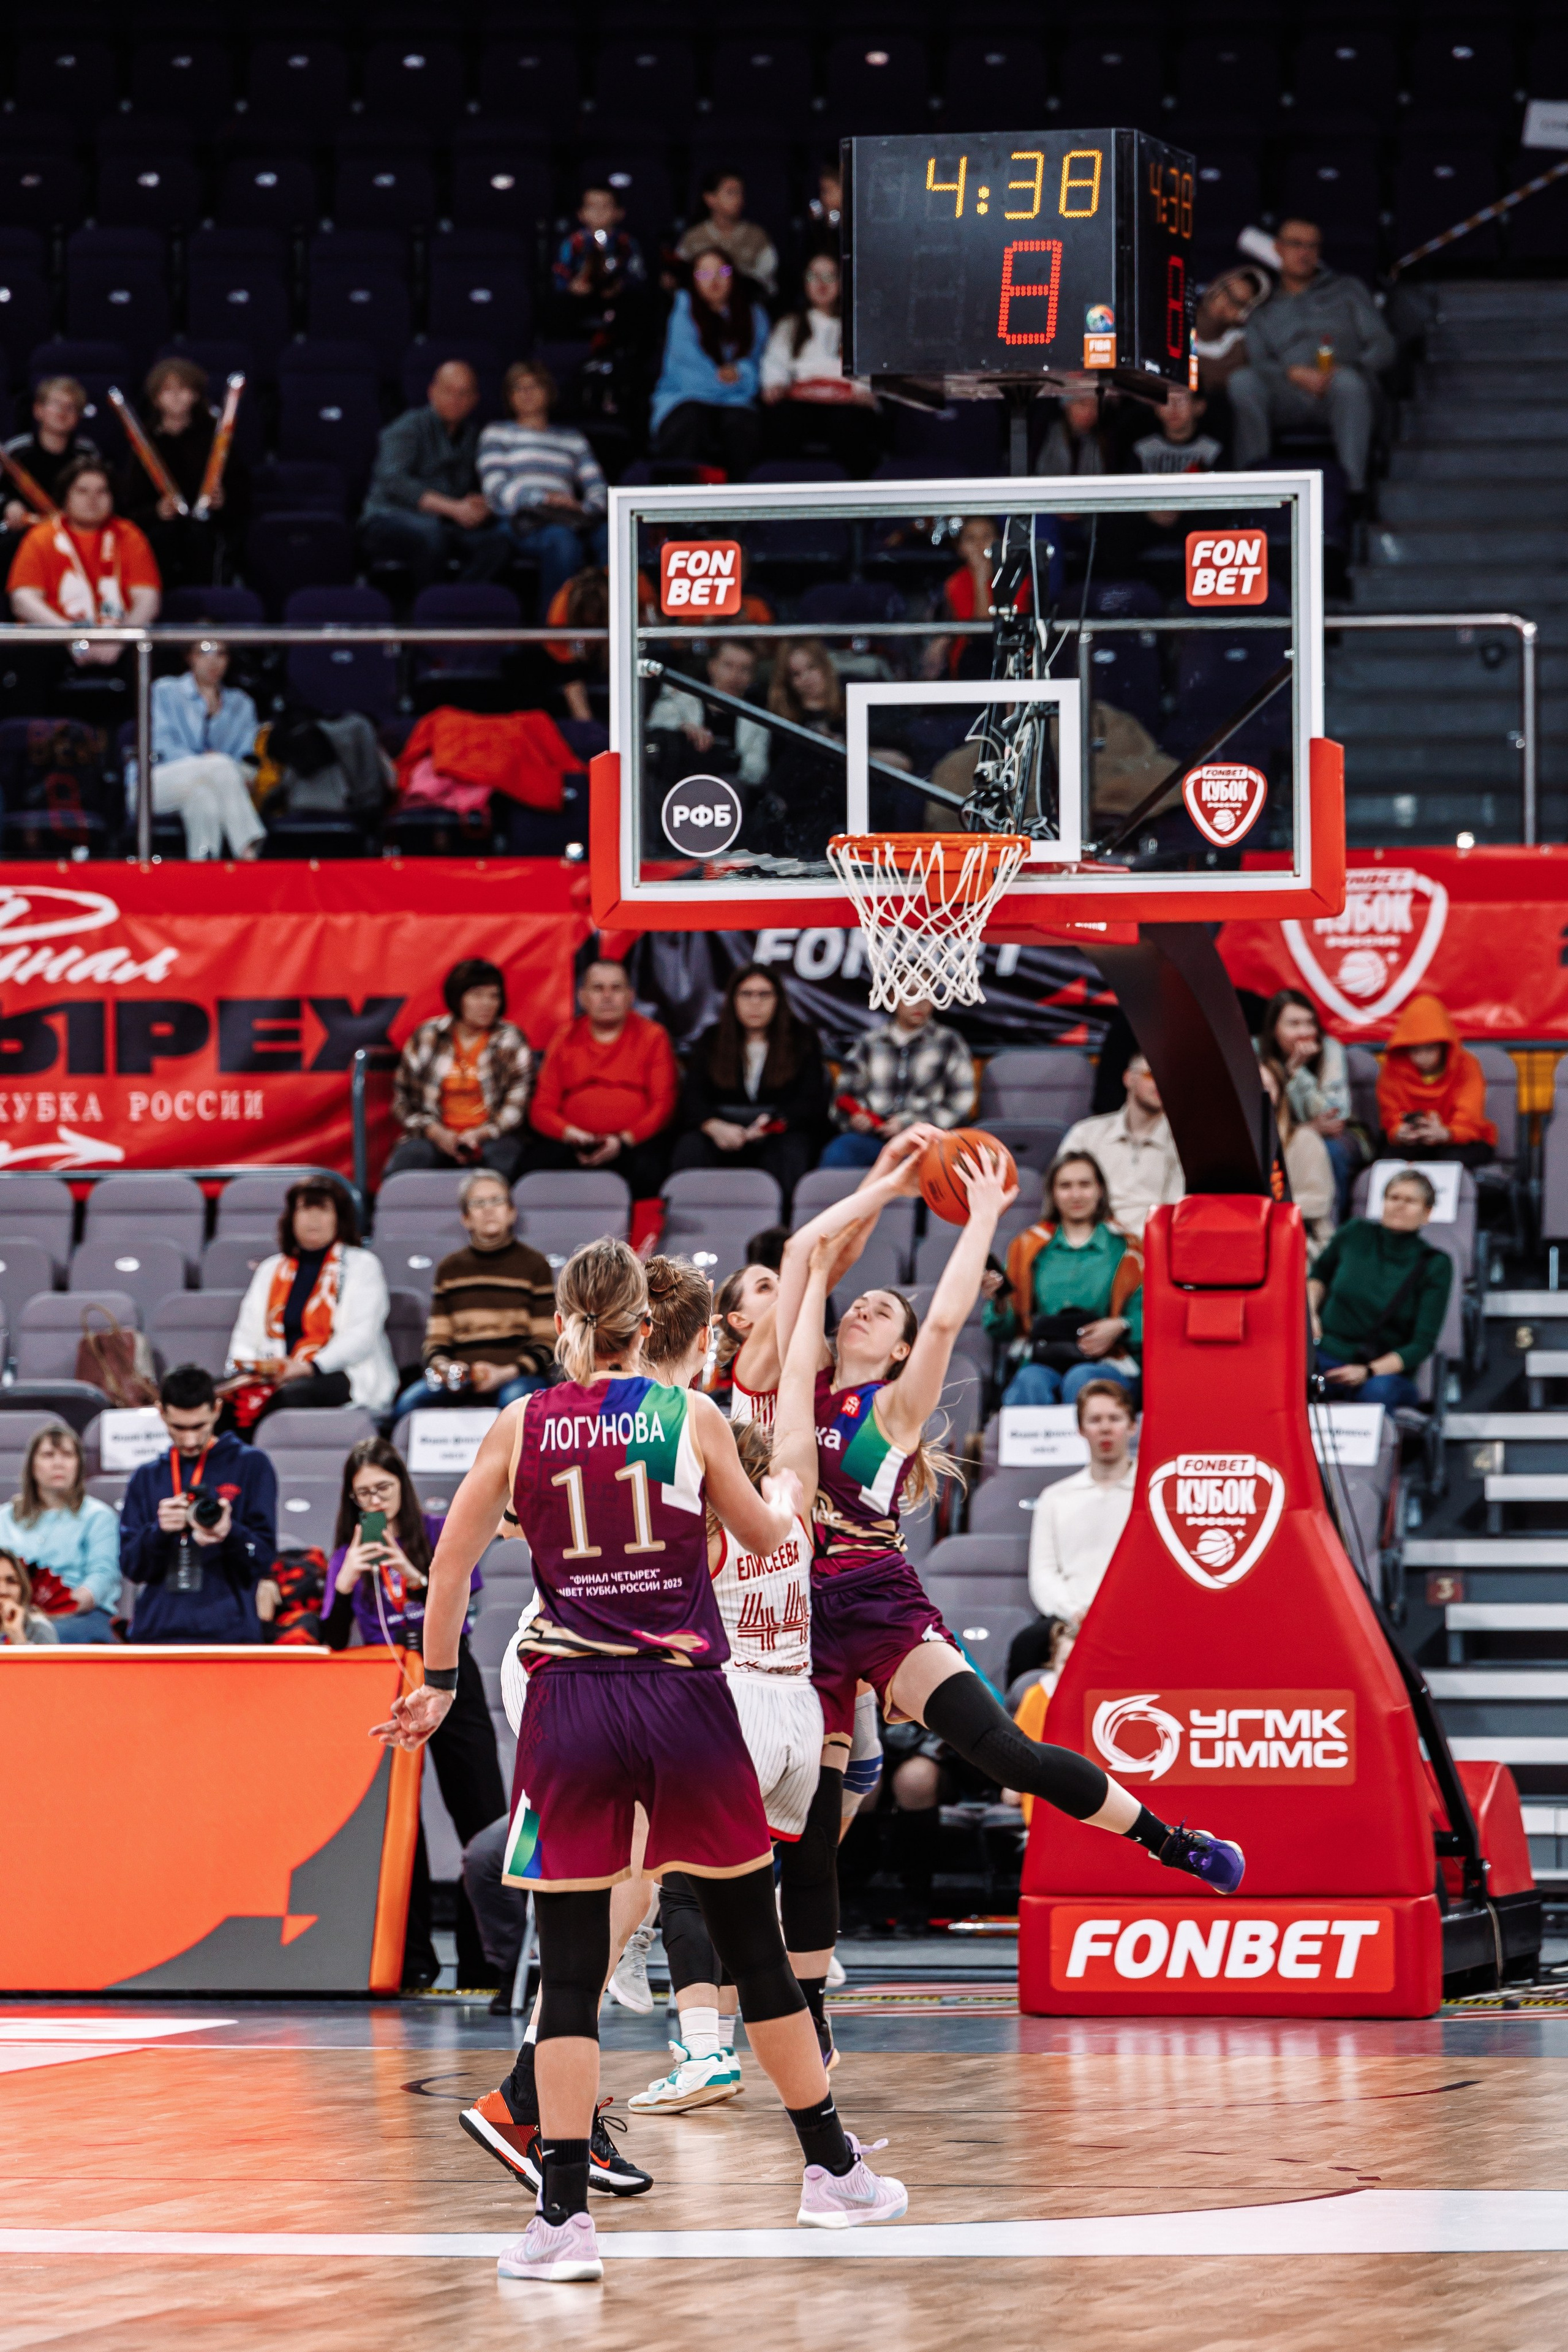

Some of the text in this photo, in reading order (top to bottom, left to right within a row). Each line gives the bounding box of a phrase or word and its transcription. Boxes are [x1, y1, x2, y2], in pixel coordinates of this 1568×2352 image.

[926, 149, 1102, 219] 4:38
[1150, 162, 1193, 239] 4:38
[998, 239, 1063, 345] 8
[1166, 254, 1185, 360] 8
[666, 549, 736, 578] FON
[1191, 538, 1262, 567] FON
[666, 577, 736, 606] BET
[1191, 567, 1262, 597] BET
[1201, 780, 1249, 802] КУБОК
[673, 804, 732, 828] РФБ
[128, 1090, 265, 1121] РОССИИ
[540, 1411, 666, 1452] ЛОГУНОВА
[1184, 1460, 1249, 1471] FONBET
[551, 1460, 666, 1560] 11
[1176, 1479, 1257, 1515] КУБОК
[570, 1568, 660, 1585] "ФИНАЛ ЧЕТЫРЕХ"
[586, 1585, 618, 1596] КУБКА
[620, 1580, 660, 1594] РОССИИ
[663, 1577, 682, 1589] 2025
[1436, 1577, 1453, 1599] 3
[1189, 1709, 1347, 1738] УГМК
[1189, 1741, 1348, 1768] UMMC
[1065, 1918, 1381, 1979] FONBET
